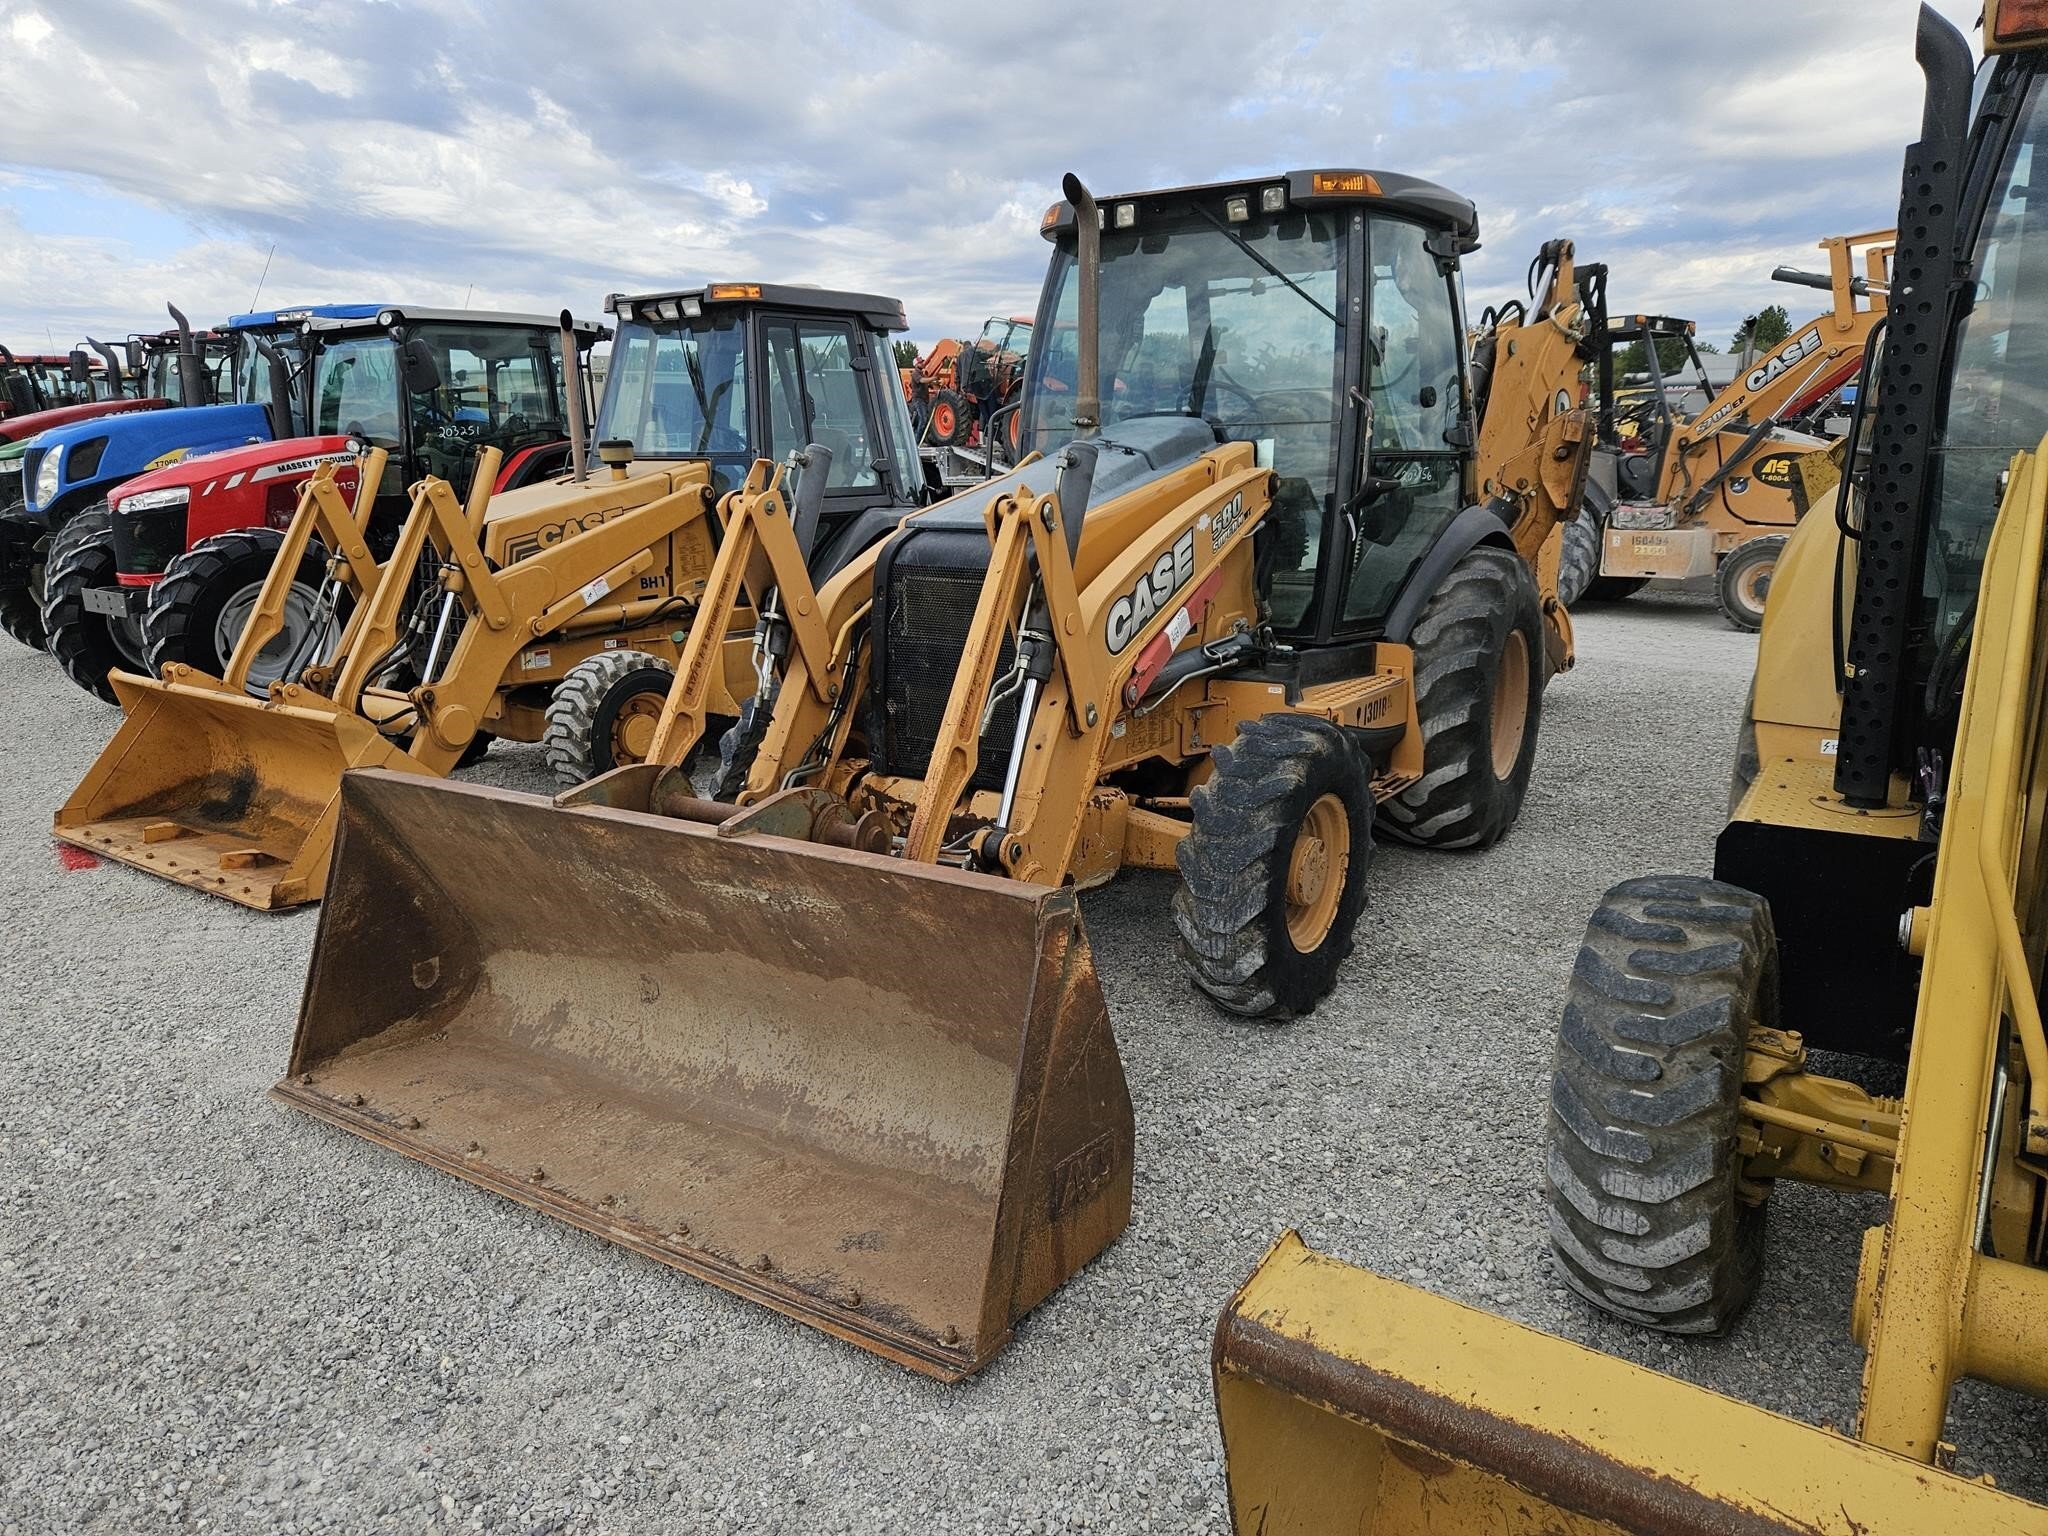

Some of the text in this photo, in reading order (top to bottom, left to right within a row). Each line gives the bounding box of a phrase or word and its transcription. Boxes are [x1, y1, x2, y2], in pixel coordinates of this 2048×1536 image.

[1746, 327, 1822, 392] CASE
[438, 425, 480, 439] 203251
[277, 455, 357, 473] MASSEY FGUSON
[1761, 474, 1791, 483] 1-800-6
[1211, 490, 1243, 541] 580
[1212, 519, 1239, 554] SUPER
[1105, 526, 1194, 656] CASE
